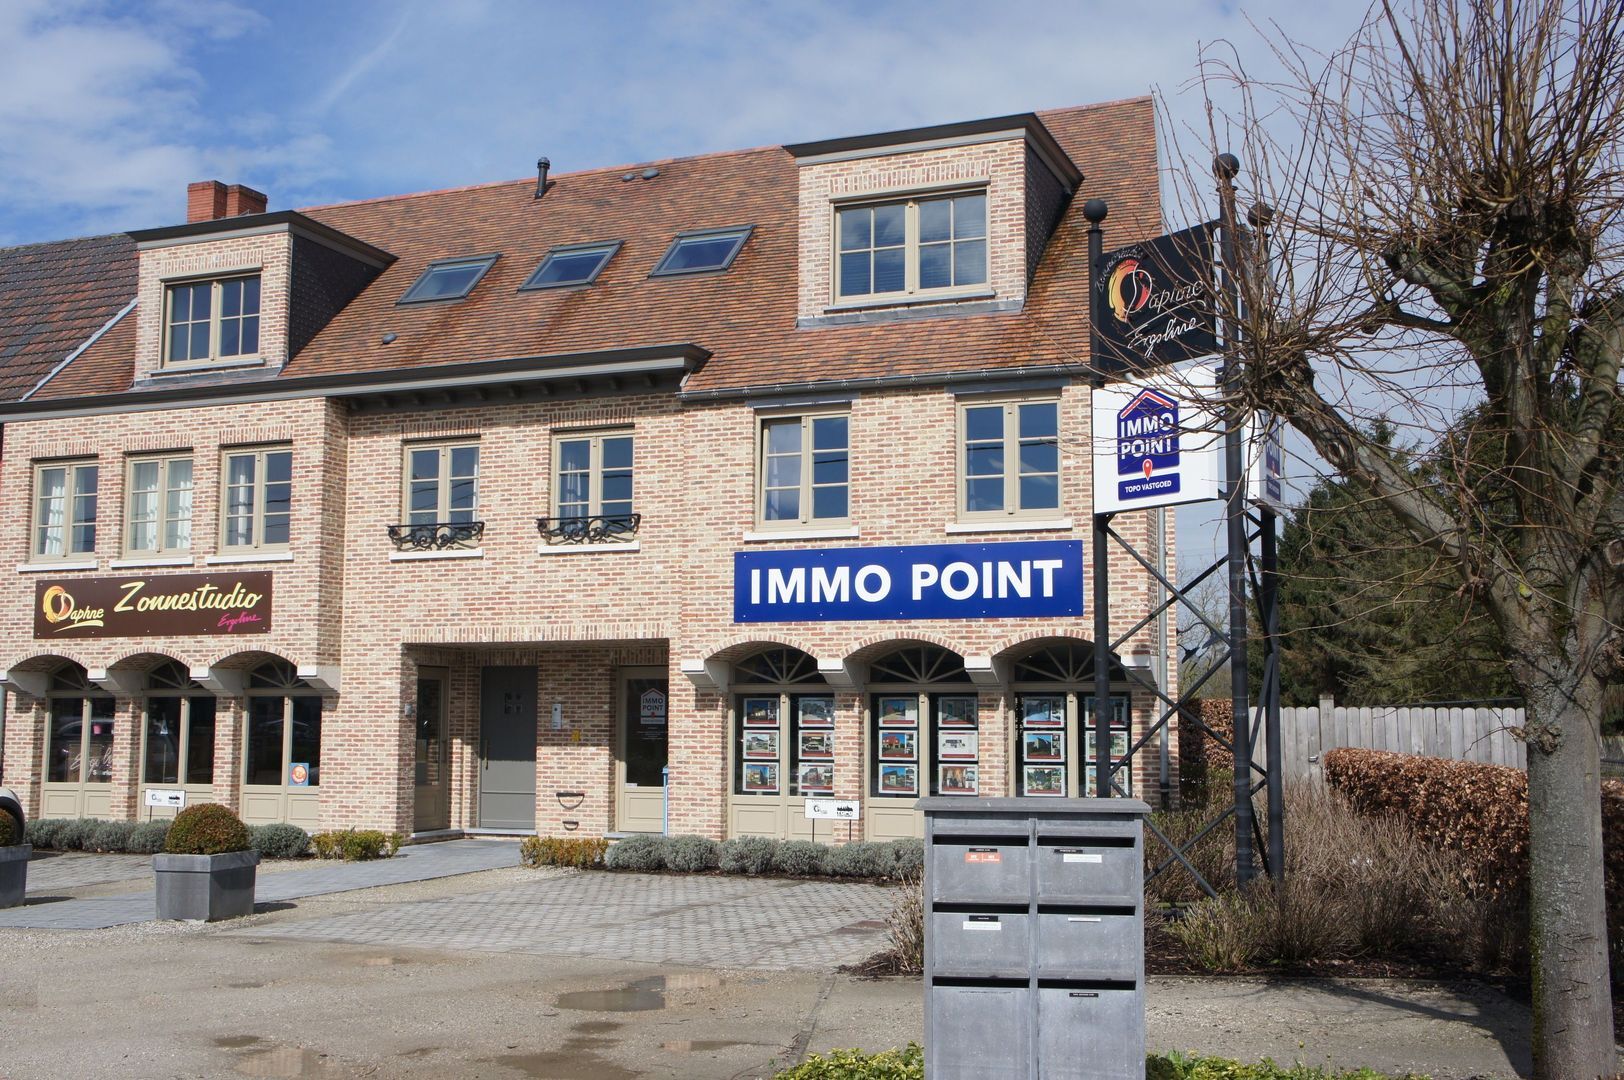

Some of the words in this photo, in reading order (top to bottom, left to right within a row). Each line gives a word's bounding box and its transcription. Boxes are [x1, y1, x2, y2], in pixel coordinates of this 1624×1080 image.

[1128, 317, 1206, 358] Ergoline
[1120, 413, 1174, 438] IMMO
[1121, 434, 1174, 460] POINT
[1124, 486, 1141, 494] TOPO
[1141, 480, 1172, 491] VASTGOED
[751, 564, 892, 605] IMMO
[911, 559, 1063, 601] POINT
[50, 589, 104, 624] Daphne
[114, 581, 262, 612] Zonnestudio
